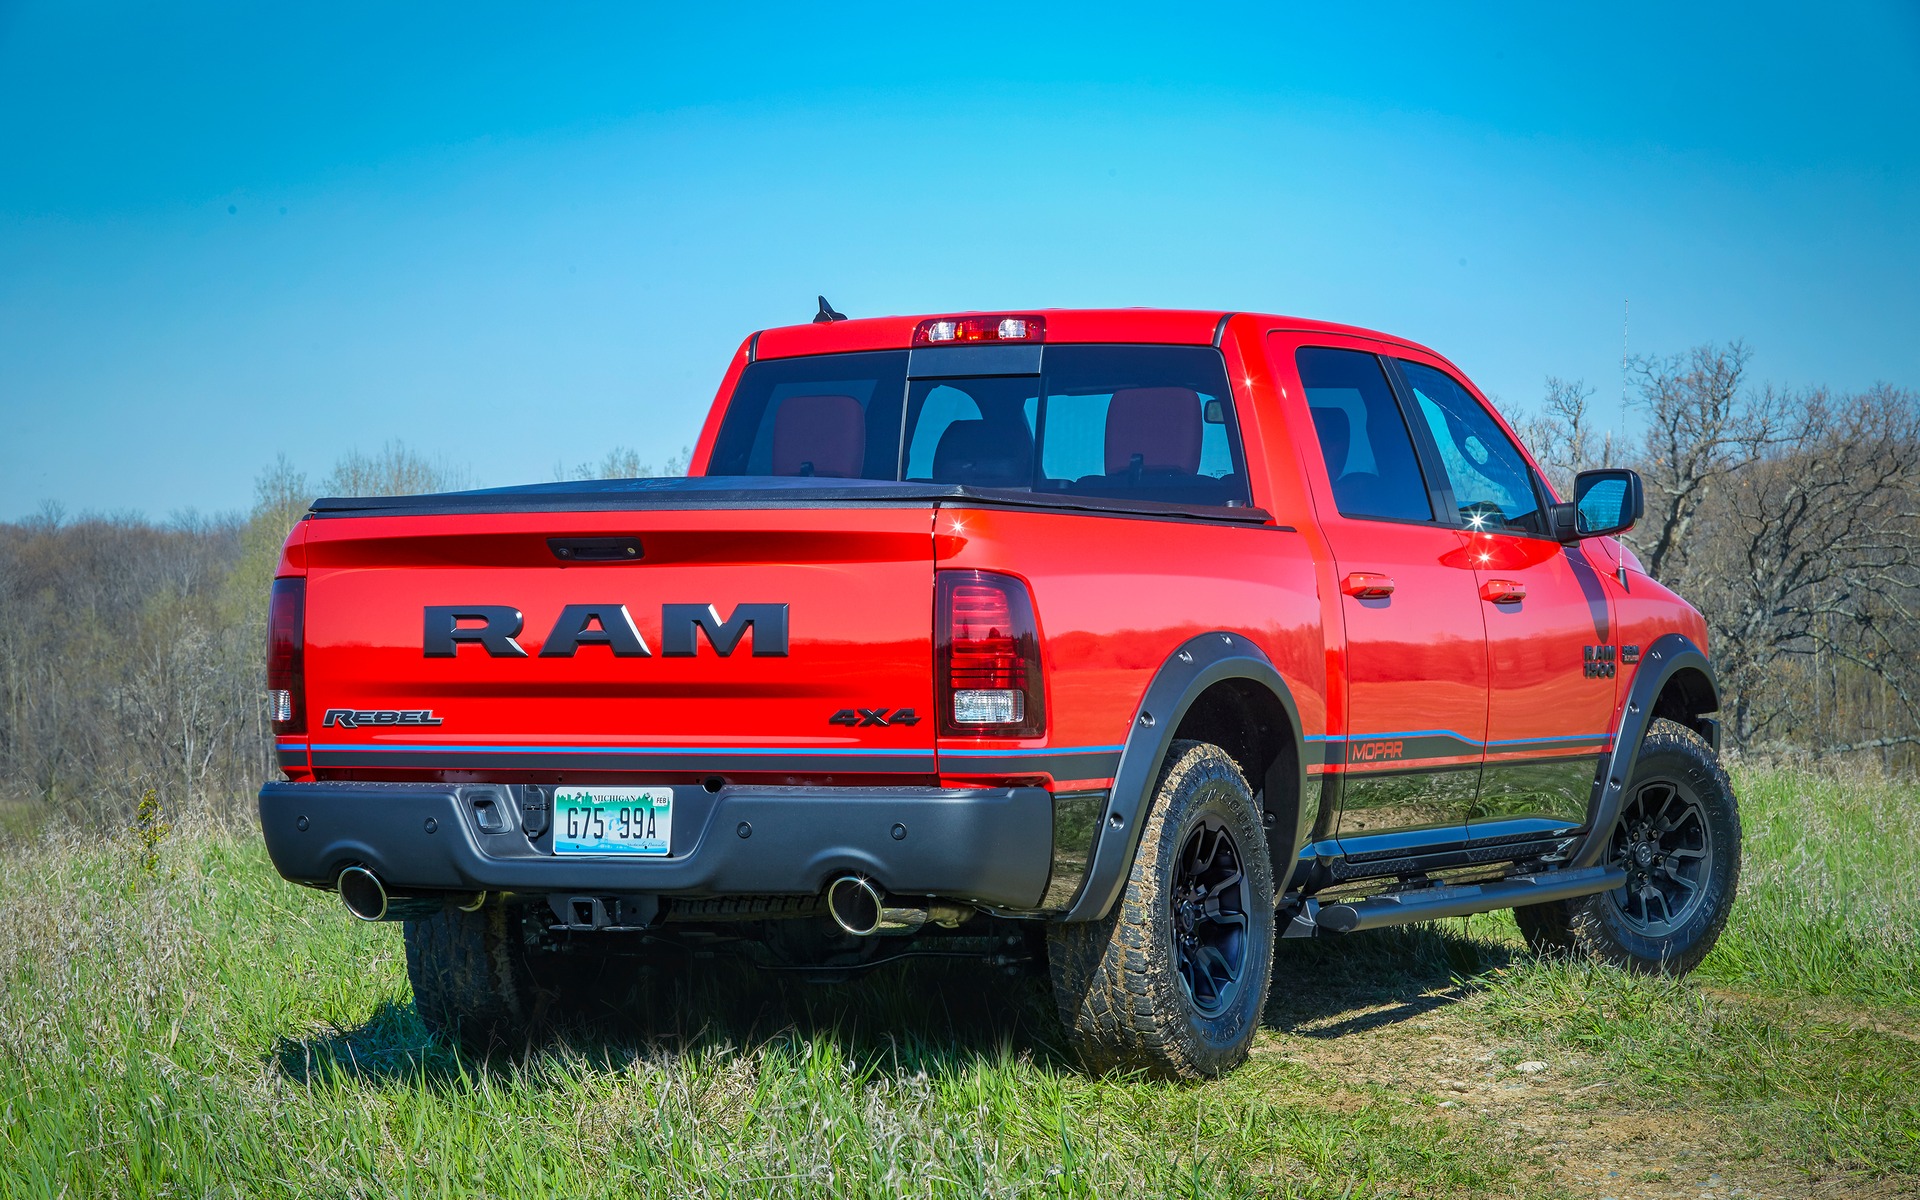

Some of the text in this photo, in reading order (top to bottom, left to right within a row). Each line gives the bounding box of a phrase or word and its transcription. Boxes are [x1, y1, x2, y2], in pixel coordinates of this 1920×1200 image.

[424, 603, 790, 658] RAM
[1583, 645, 1616, 661] RAM
[1583, 661, 1616, 679] 1500
[322, 709, 444, 729] REBEL
[829, 708, 921, 727] 4X4
[1352, 741, 1404, 760] MOPAR
[593, 794, 637, 803] MICHIGAN
[567, 807, 656, 839] G75 99A
